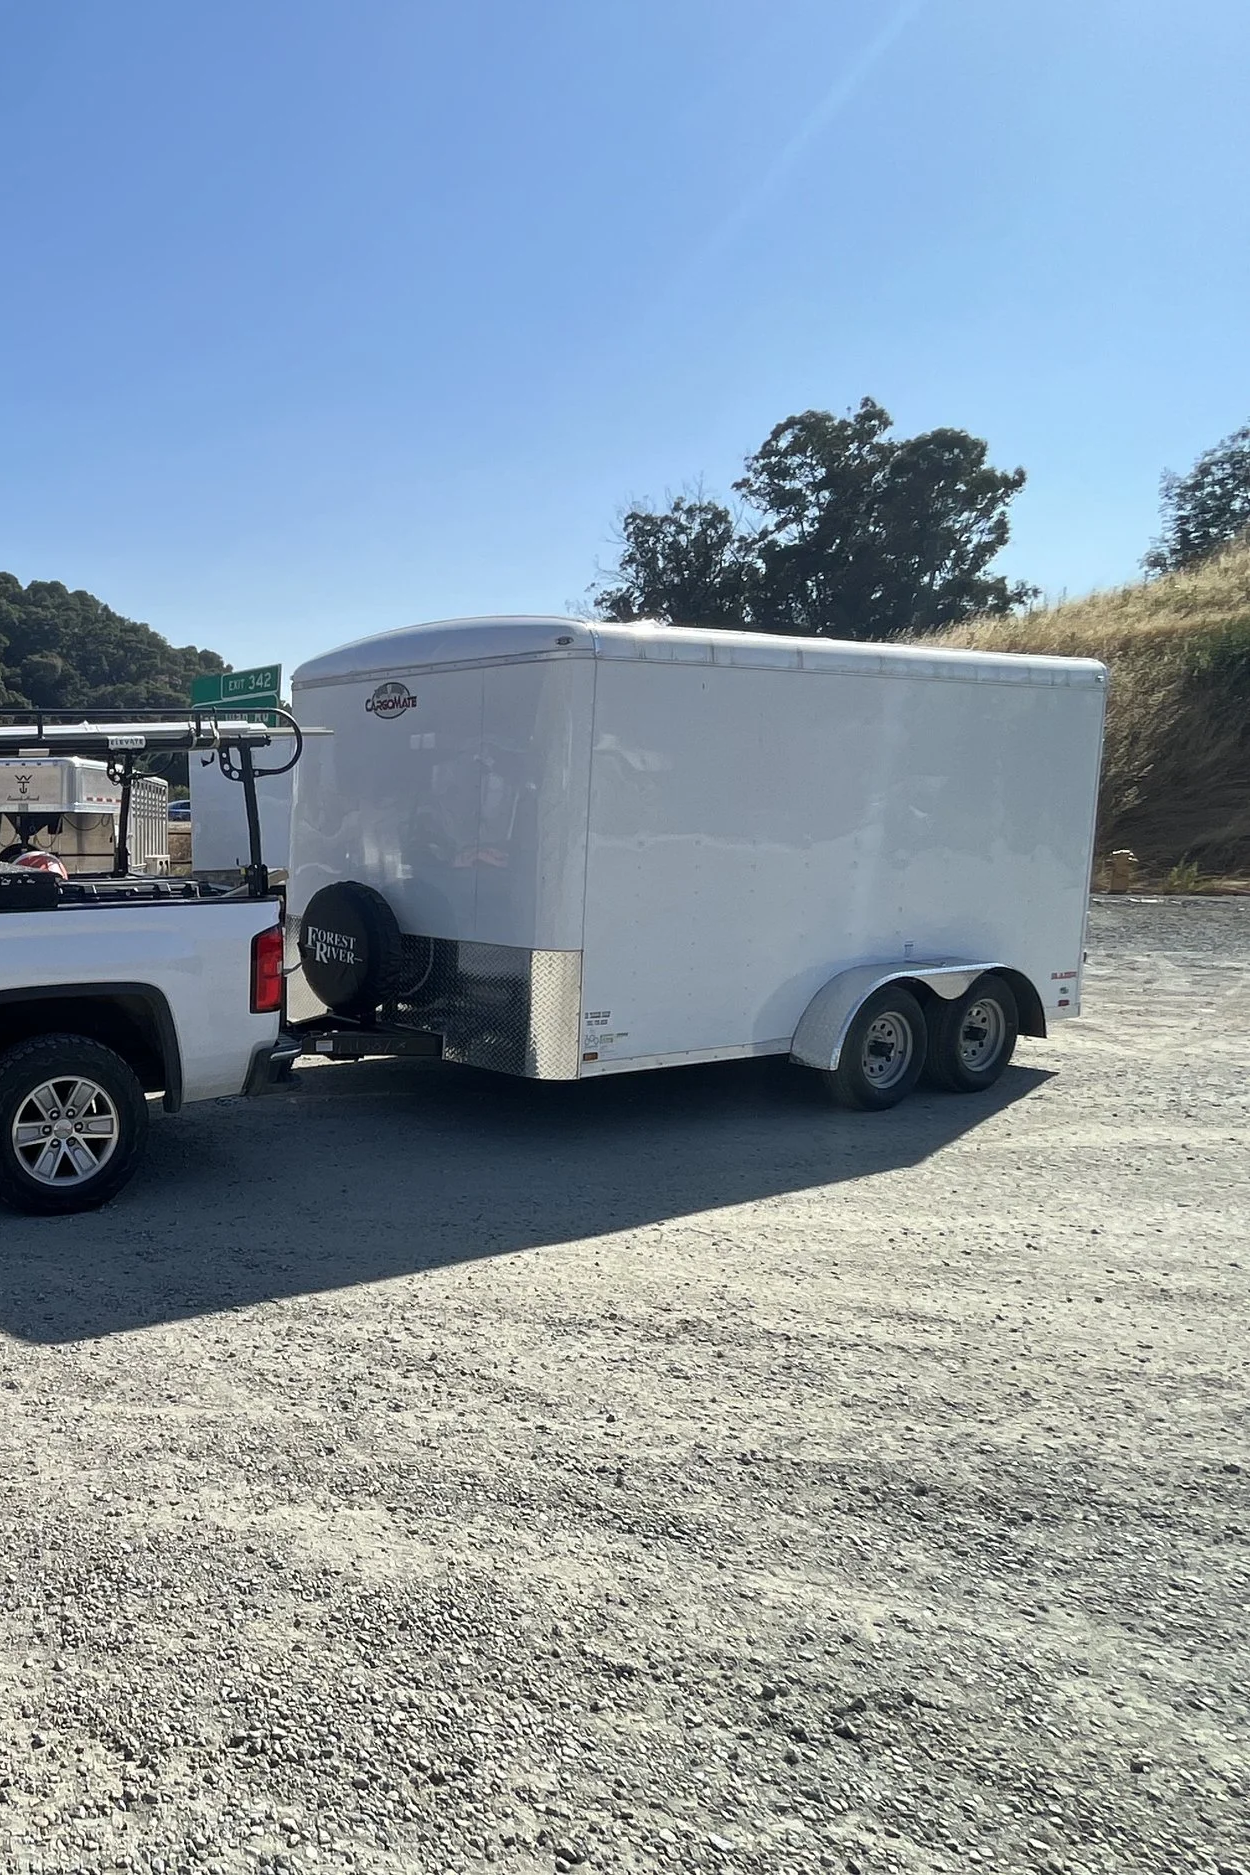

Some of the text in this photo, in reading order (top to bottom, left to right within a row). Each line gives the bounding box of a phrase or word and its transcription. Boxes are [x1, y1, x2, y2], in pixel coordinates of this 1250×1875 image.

[228, 672, 272, 692] EXIT 342
[307, 926, 356, 949] FOREST
[315, 941, 354, 964] RIVER
